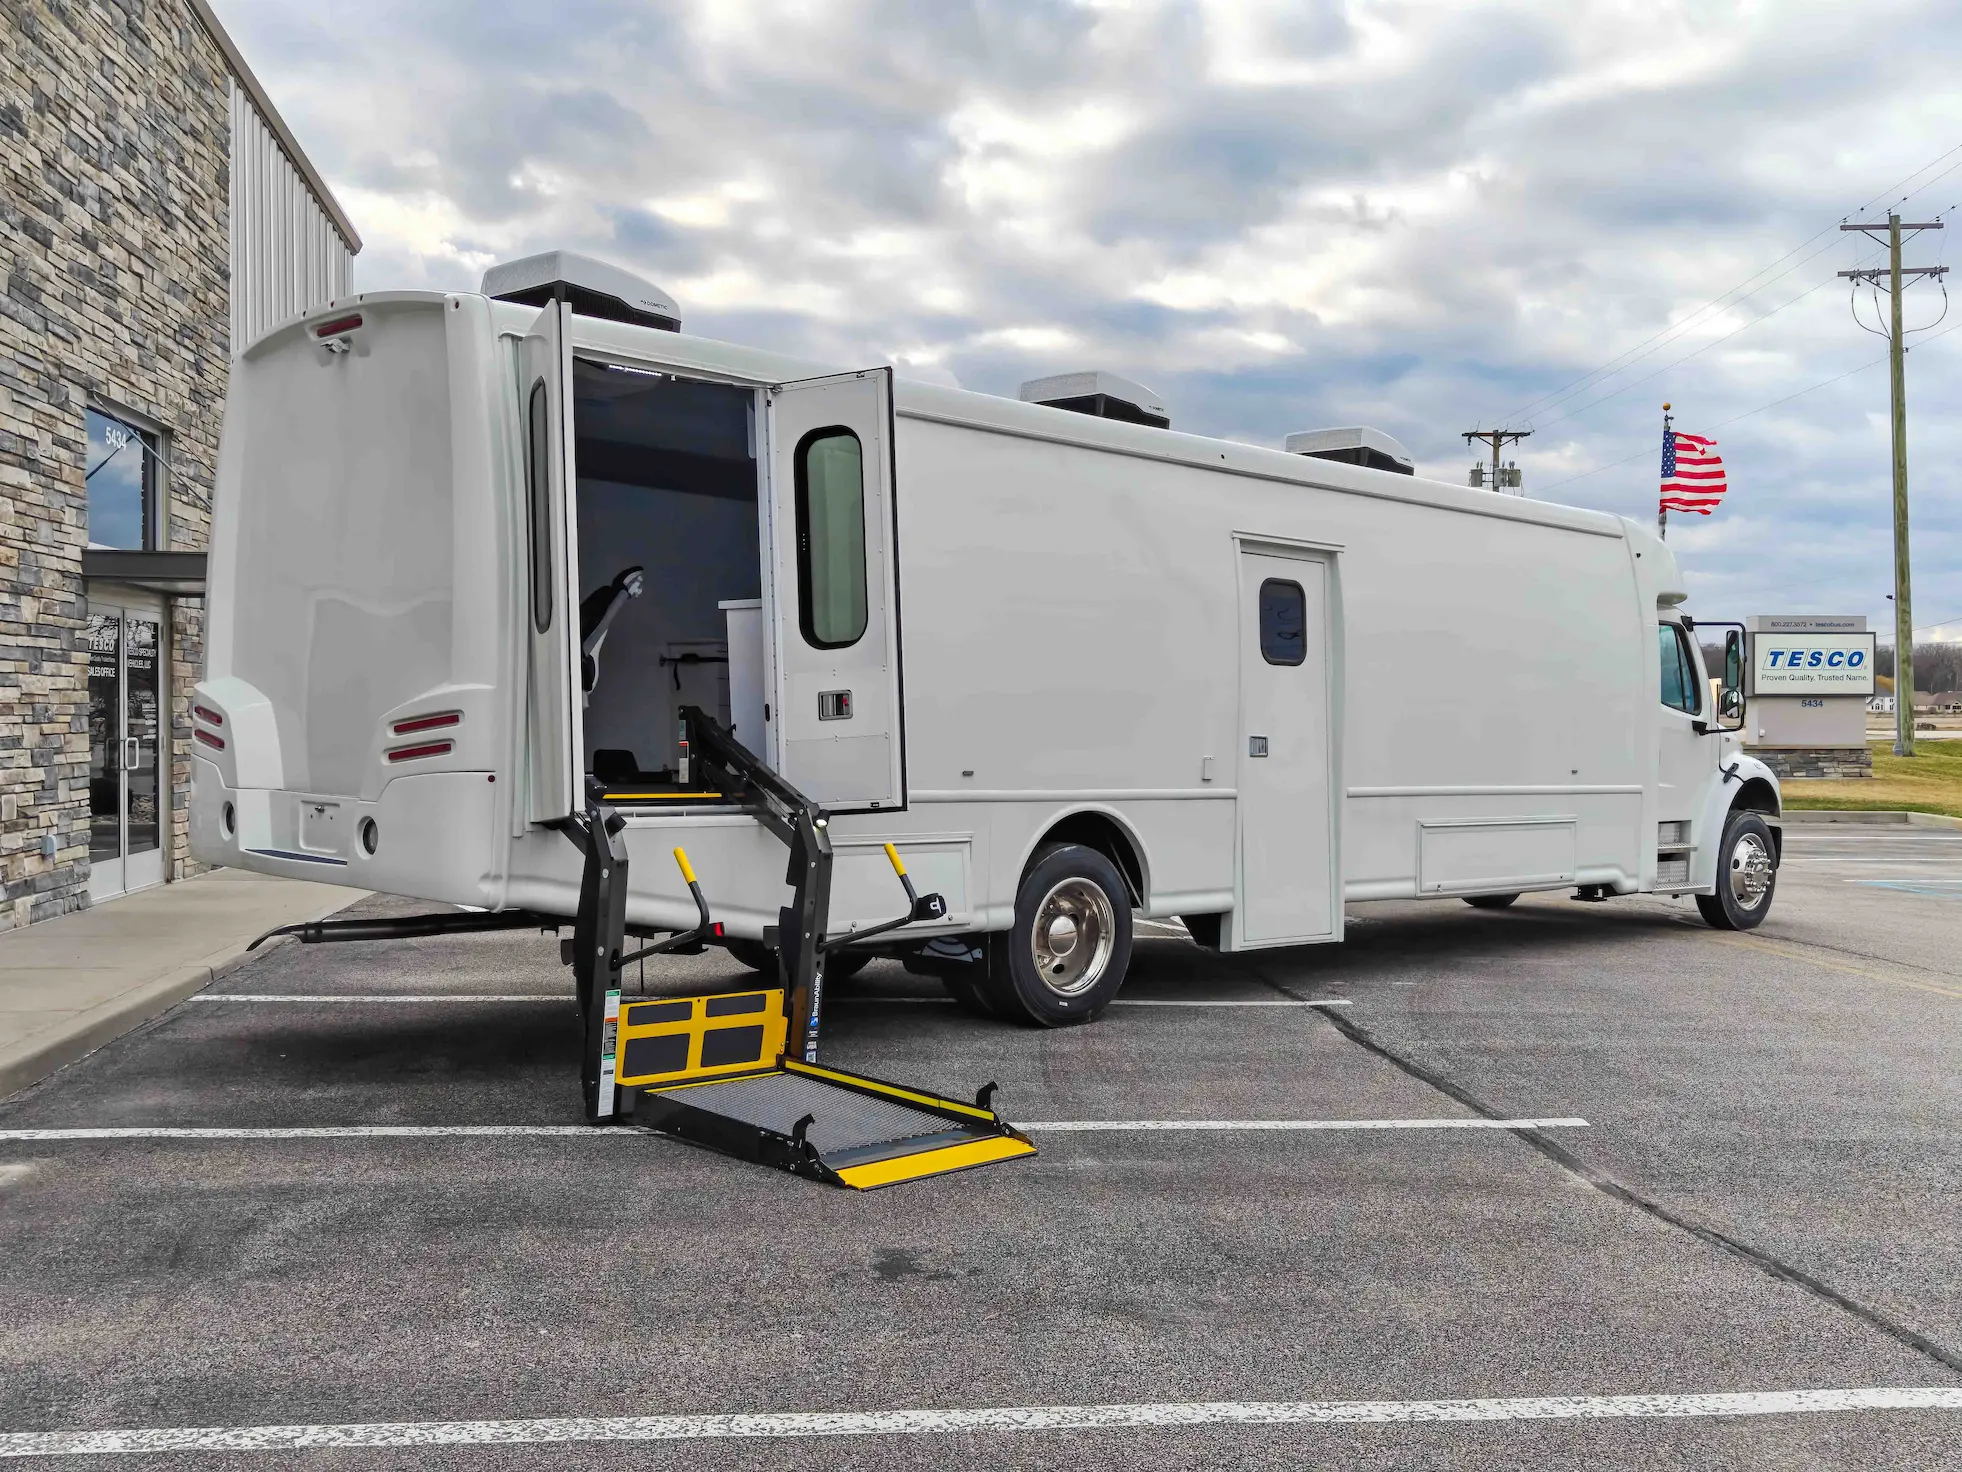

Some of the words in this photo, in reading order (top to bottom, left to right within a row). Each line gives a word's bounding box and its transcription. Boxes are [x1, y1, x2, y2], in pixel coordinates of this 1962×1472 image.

[647, 301, 668, 310] DOMETIC
[105, 426, 127, 451] 5434
[88, 636, 114, 651] TESCO
[1769, 652, 1864, 667] TESCO
[88, 666, 100, 677] SALES
[100, 667, 116, 678] OFFICE
[1788, 674, 1816, 683] Quality.
[812, 972, 822, 1016] BraunAbility
